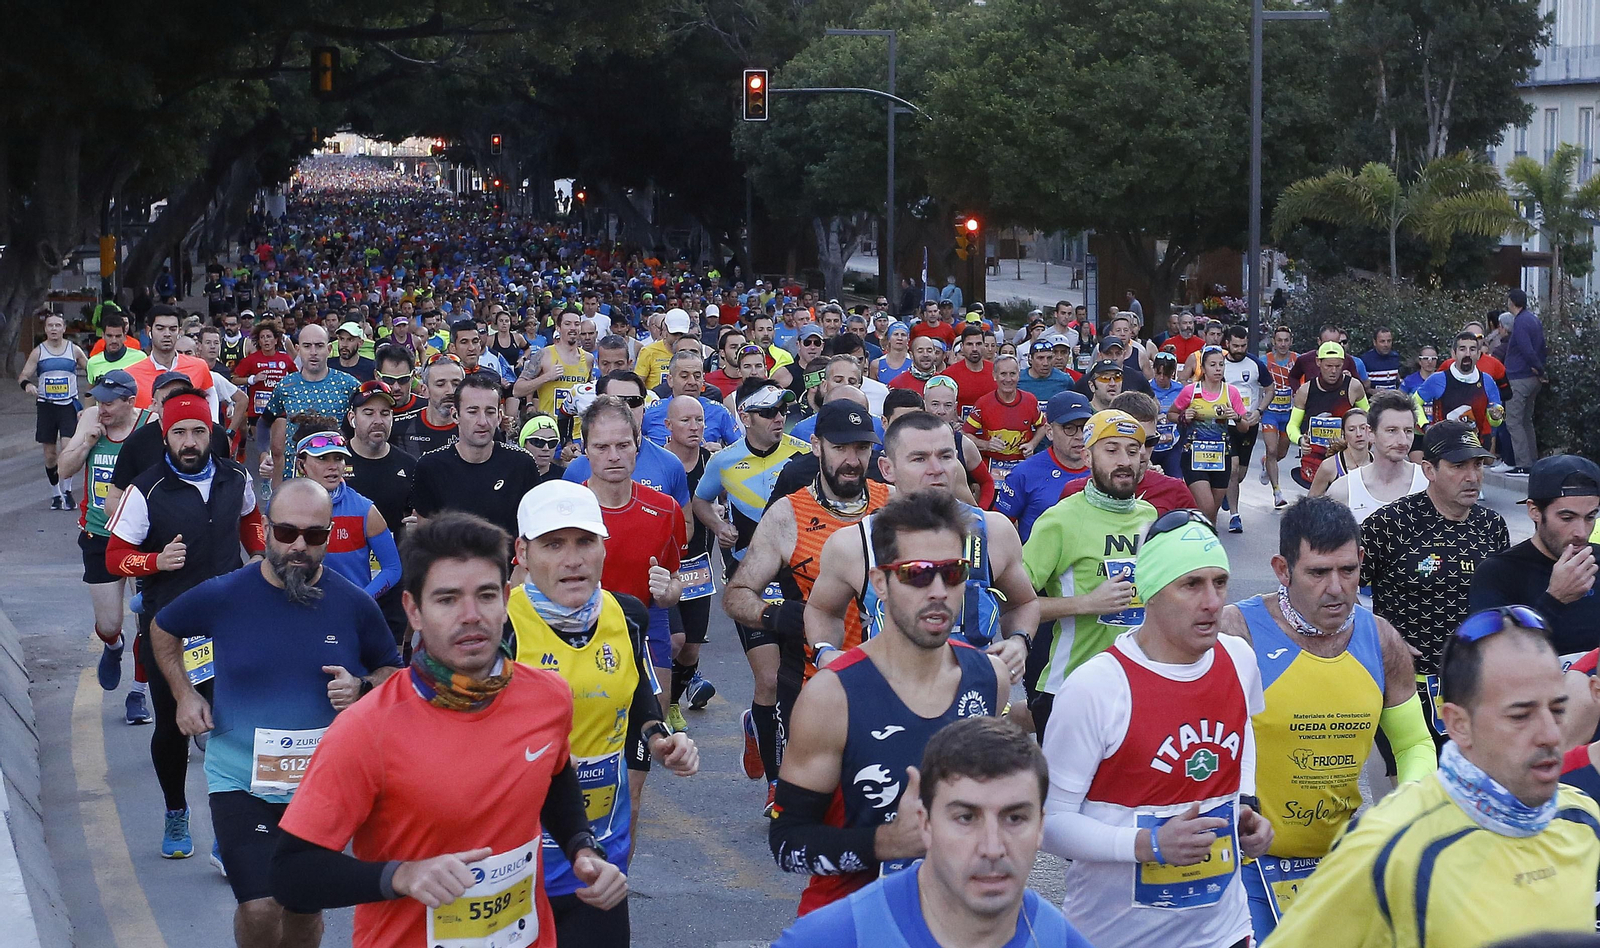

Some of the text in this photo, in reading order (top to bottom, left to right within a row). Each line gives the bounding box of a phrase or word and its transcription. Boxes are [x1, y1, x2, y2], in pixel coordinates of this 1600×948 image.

[1460, 559, 1475, 572] tri
[679, 571, 700, 583] 2072
[191, 646, 210, 661] 978
[1289, 721, 1371, 732] UCEDA OROZCO
[296, 737, 322, 746] ZURIC
[1150, 718, 1240, 774] ITALIA
[1312, 754, 1356, 767] FRIODEL
[576, 767, 606, 780] URICH
[1282, 799, 1330, 827] Siglo
[490, 856, 527, 880] ZURICH
[1293, 858, 1322, 868] ZURIC
[469, 892, 511, 920] 5589
